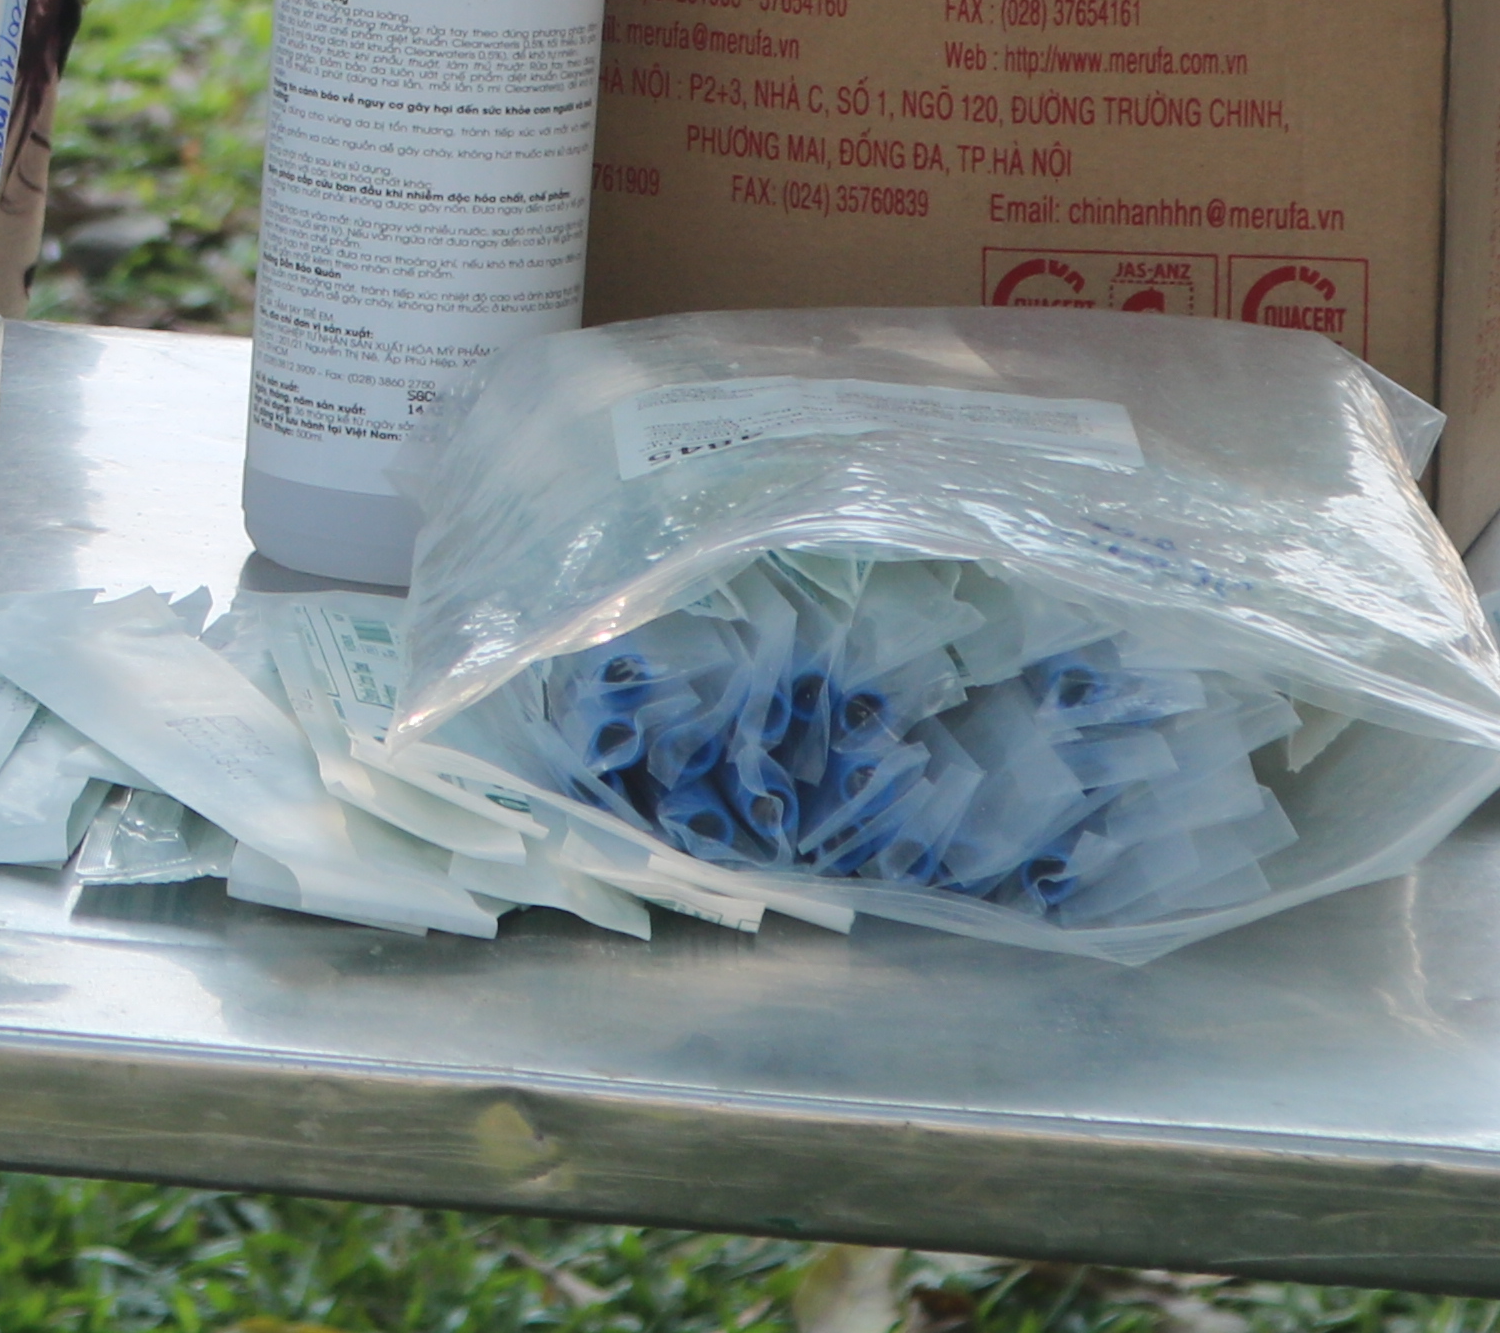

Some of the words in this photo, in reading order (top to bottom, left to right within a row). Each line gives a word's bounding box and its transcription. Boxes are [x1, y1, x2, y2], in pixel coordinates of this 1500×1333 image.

[626, 20, 800, 60] merufa@merufa.vn
[944, 40, 987, 71] Web
[1004, 43, 1248, 79] http://www.merufa.com.vn
[358, 98, 385, 109] nguy
[689, 73, 747, 109] P2+3,
[807, 84, 830, 118] C,
[877, 90, 895, 121] 1,
[960, 94, 1004, 129] 120,
[1209, 97, 1289, 133] CHINH,
[787, 133, 832, 170] MAI,
[385, 189, 403, 198] khi
[592, 162, 660, 196] 761909
[731, 174, 777, 208] FAX:
[783, 179, 831, 218] (024)
[836, 184, 930, 218] 35760839
[989, 193, 1061, 225] Email:
[1068, 196, 1346, 231] chinhanhhn@merufa.vn
[1114, 261, 1192, 282] JAS-ANZ
[407, 390, 436, 402] SGC
